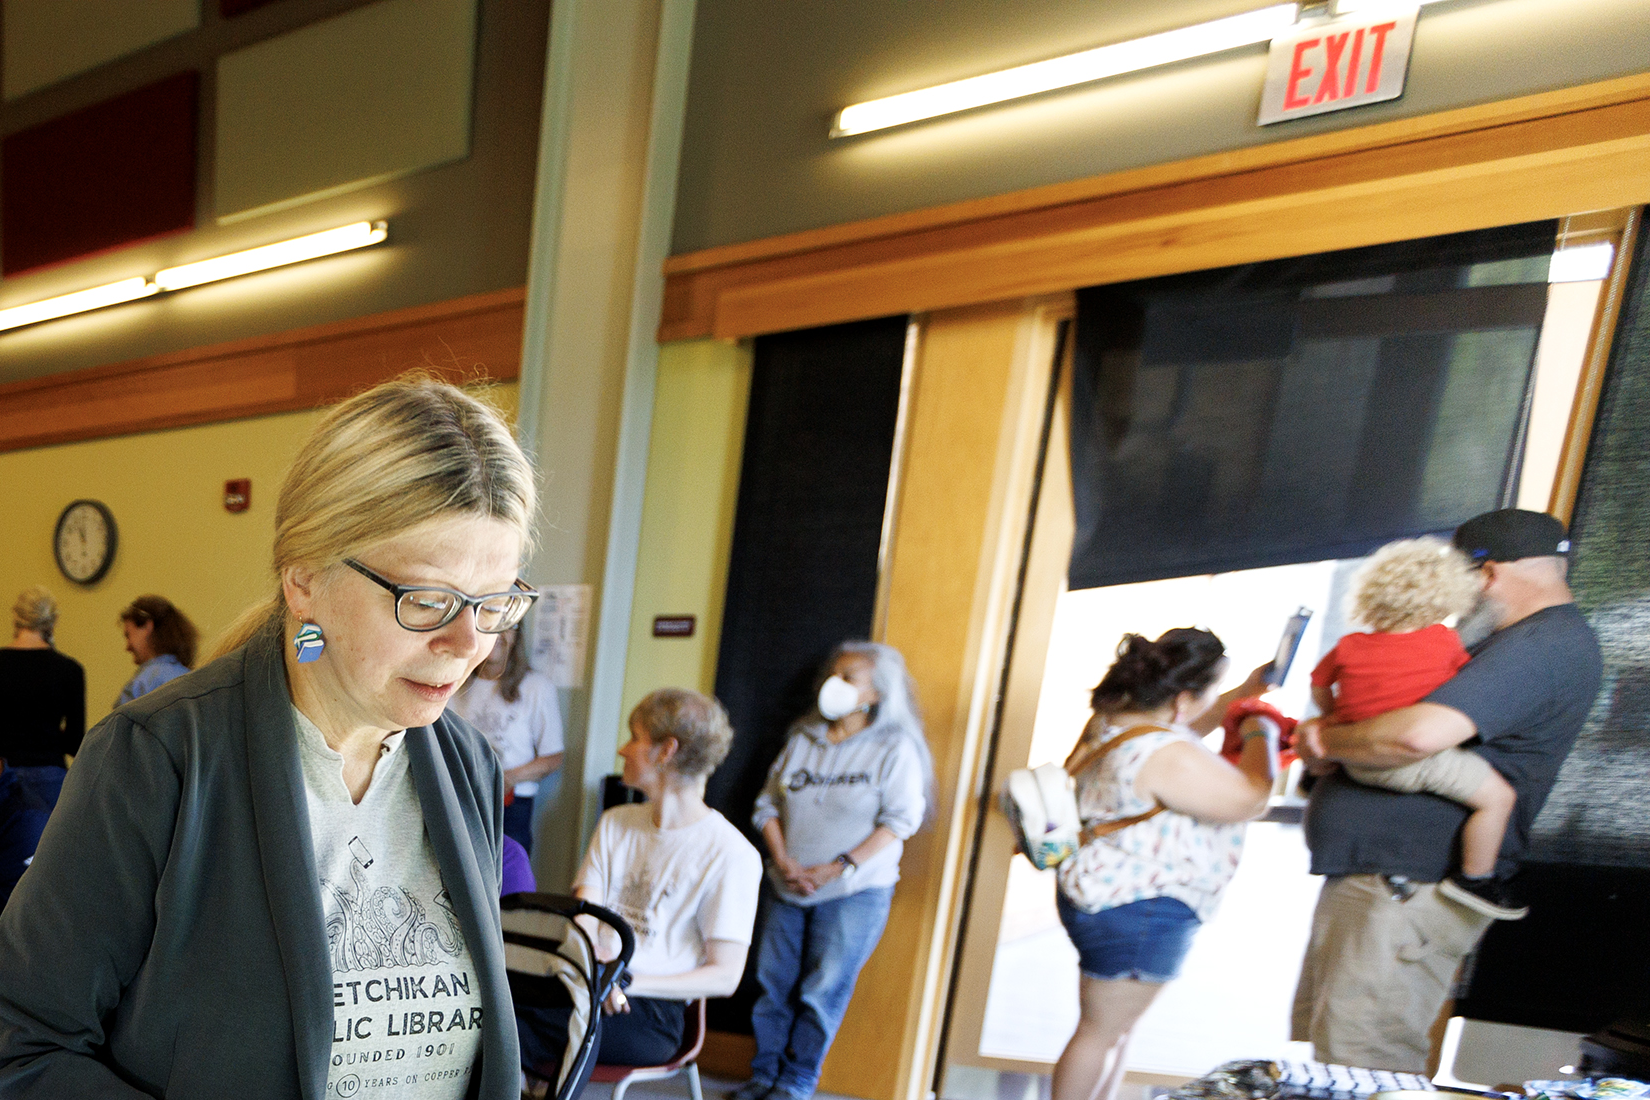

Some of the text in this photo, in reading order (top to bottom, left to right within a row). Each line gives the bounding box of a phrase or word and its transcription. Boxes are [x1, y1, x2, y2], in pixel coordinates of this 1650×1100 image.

[1282, 21, 1397, 112] EXIT
[333, 971, 471, 1007] ETCHIKAN
[332, 1007, 484, 1043] LIC LIBRAR
[332, 1042, 456, 1067] OUNDED 1901
[342, 1080, 356, 1092] 10
[364, 1076, 399, 1088] YEARS
[405, 1074, 419, 1085] ON
[424, 1069, 460, 1082] COPPER
